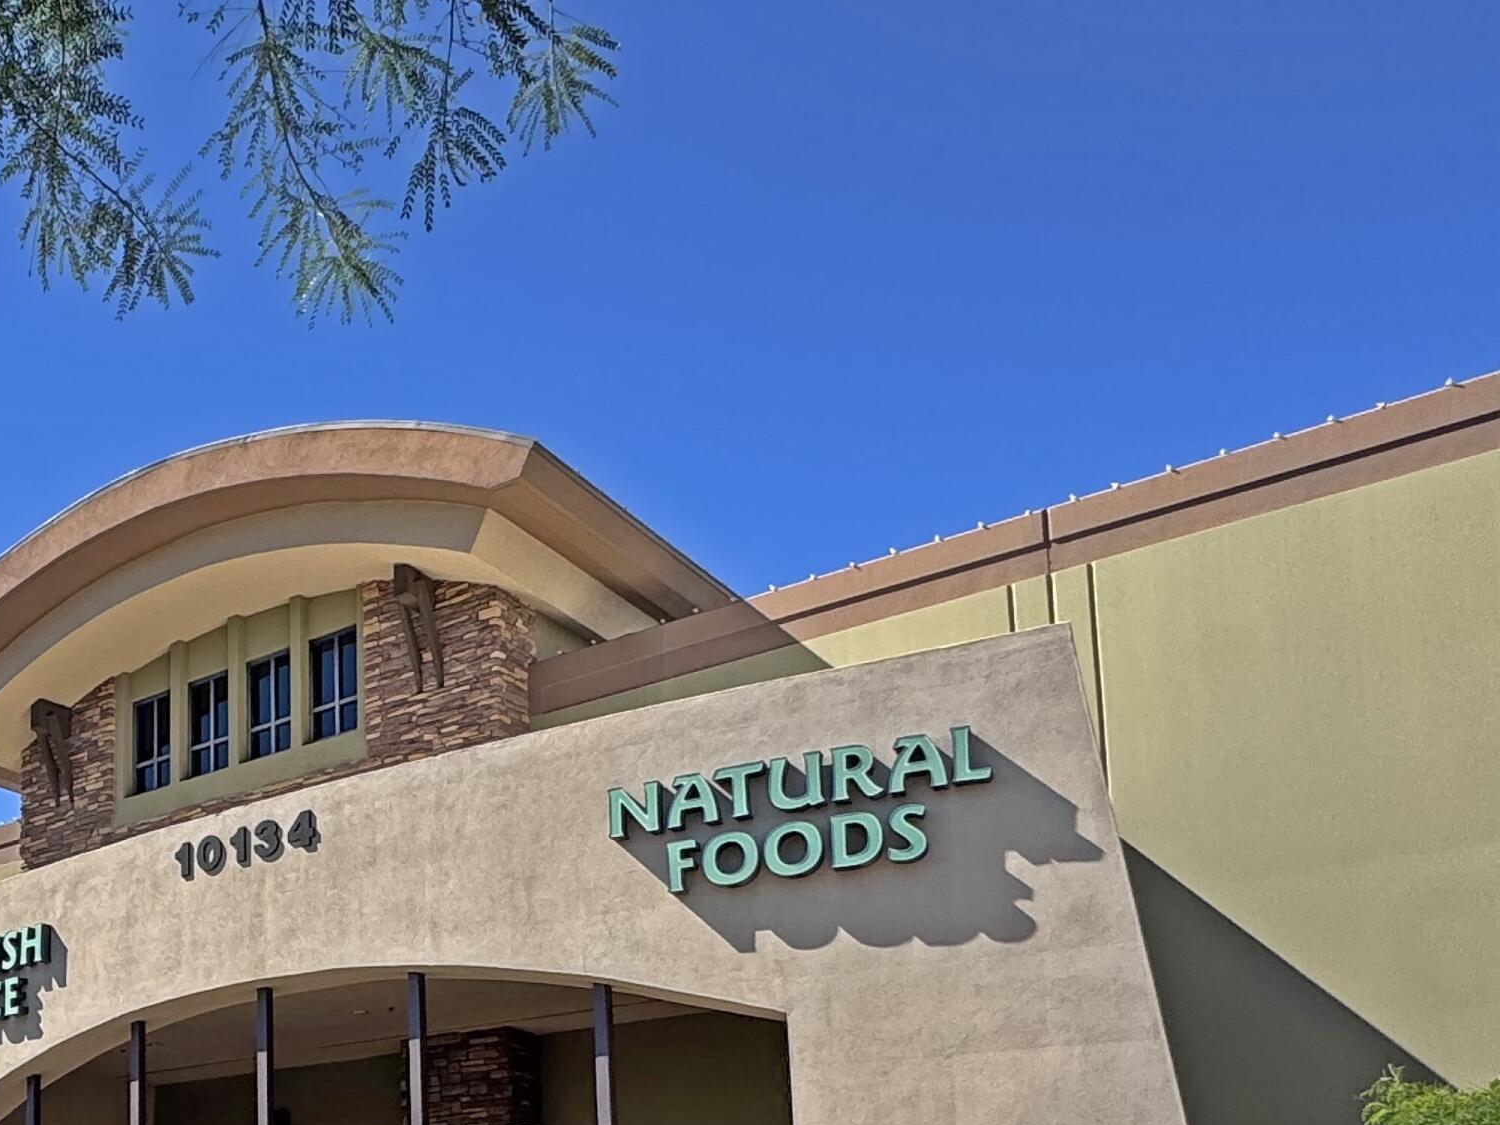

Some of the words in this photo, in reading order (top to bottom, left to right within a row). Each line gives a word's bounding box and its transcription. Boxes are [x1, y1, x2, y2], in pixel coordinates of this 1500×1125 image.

[607, 725, 994, 840] NATURAL
[175, 809, 320, 881] 10134
[666, 803, 929, 893] FOODS
